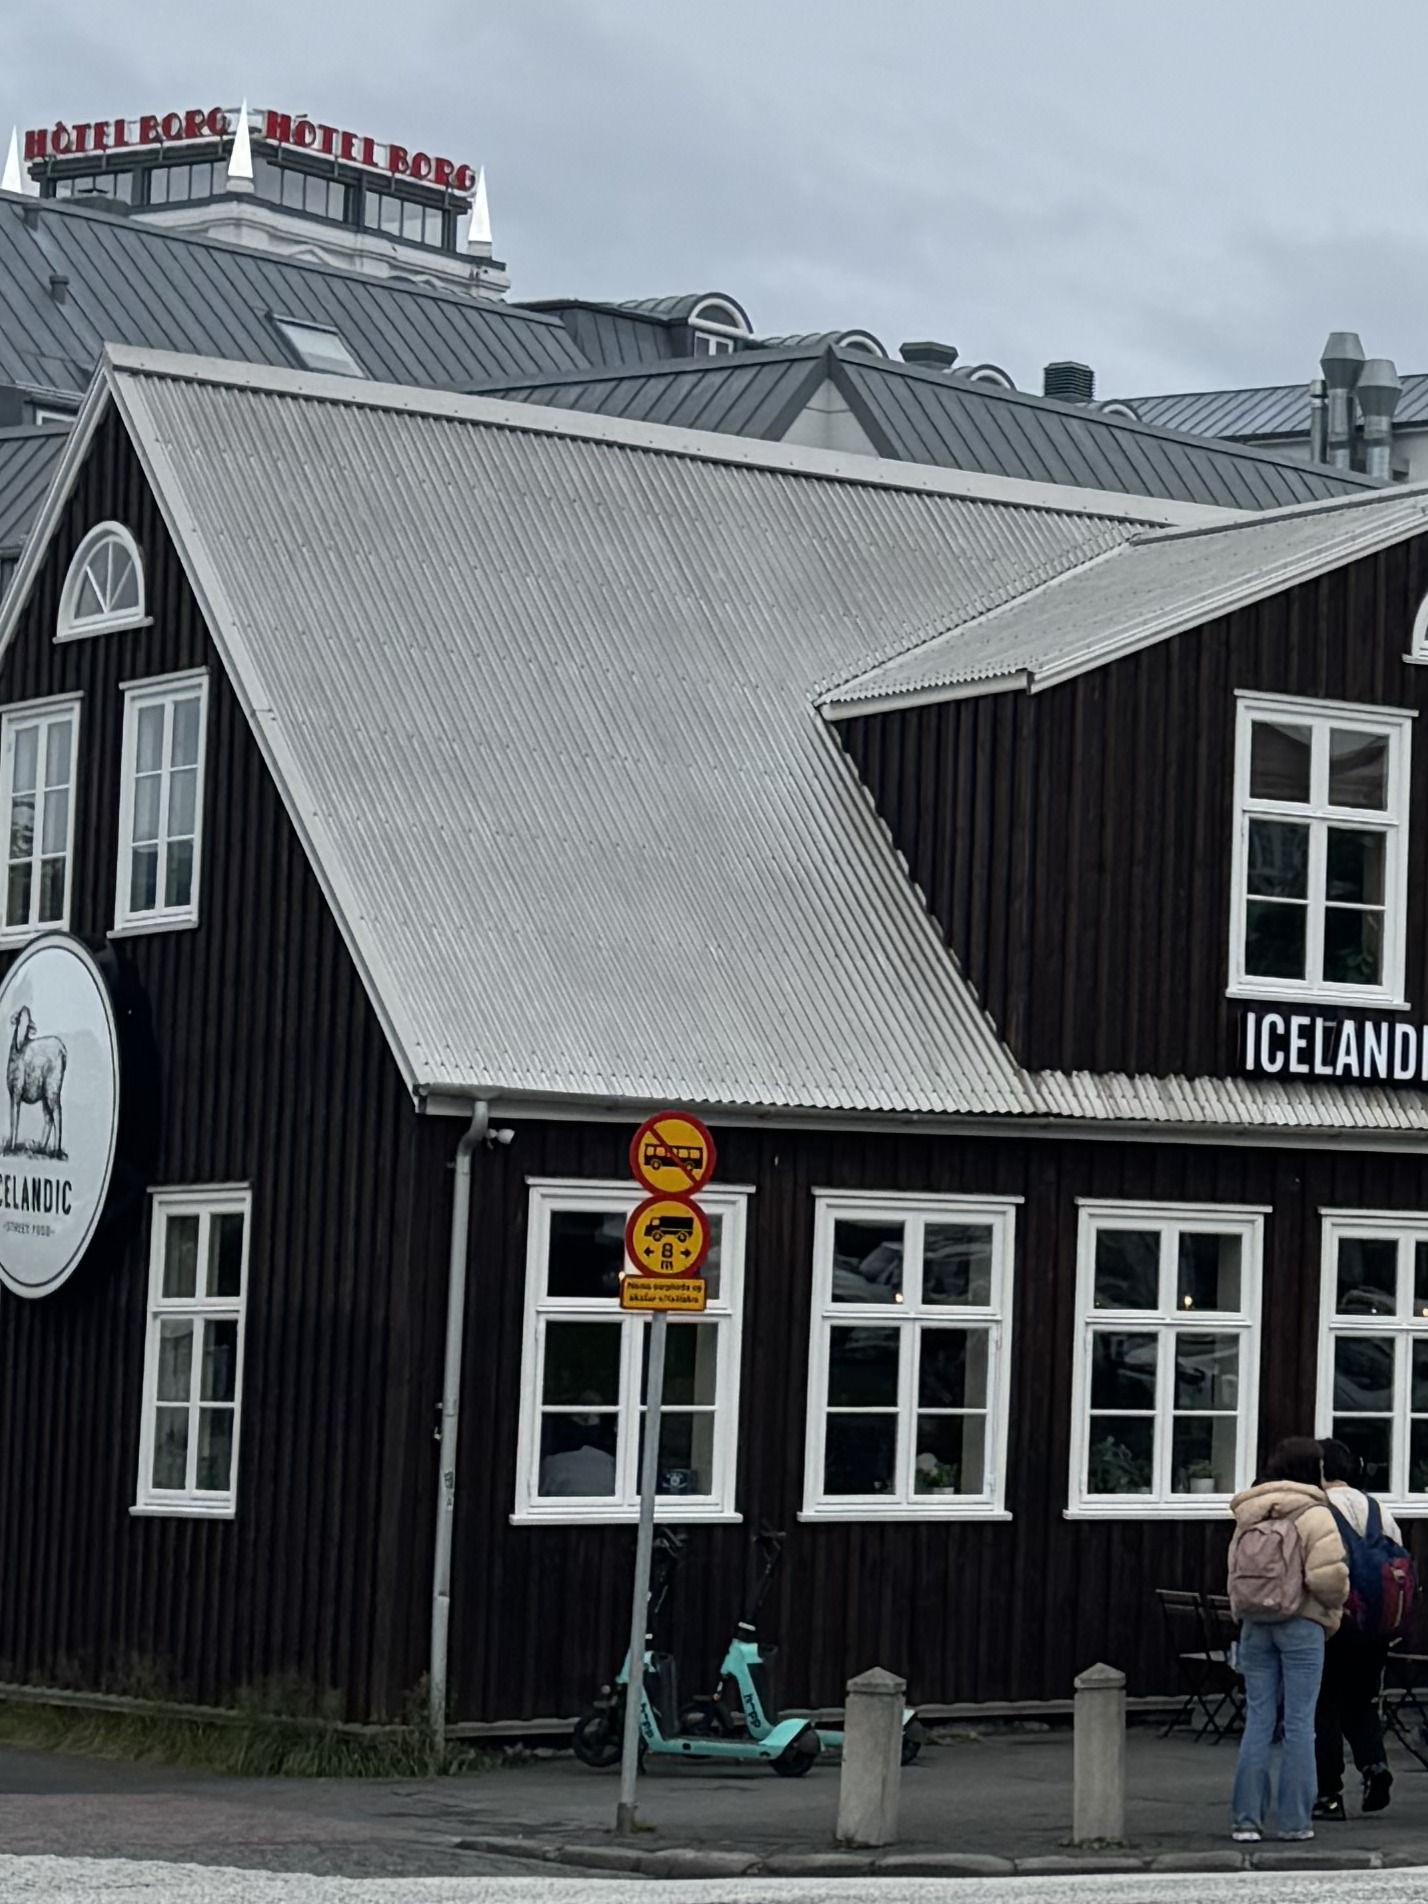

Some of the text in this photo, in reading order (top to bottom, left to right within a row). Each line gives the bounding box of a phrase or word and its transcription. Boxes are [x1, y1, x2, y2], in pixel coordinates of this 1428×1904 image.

[139, 106, 227, 146] BORG
[388, 144, 476, 192] BORG
[661, 1243, 674, 1259] 8
